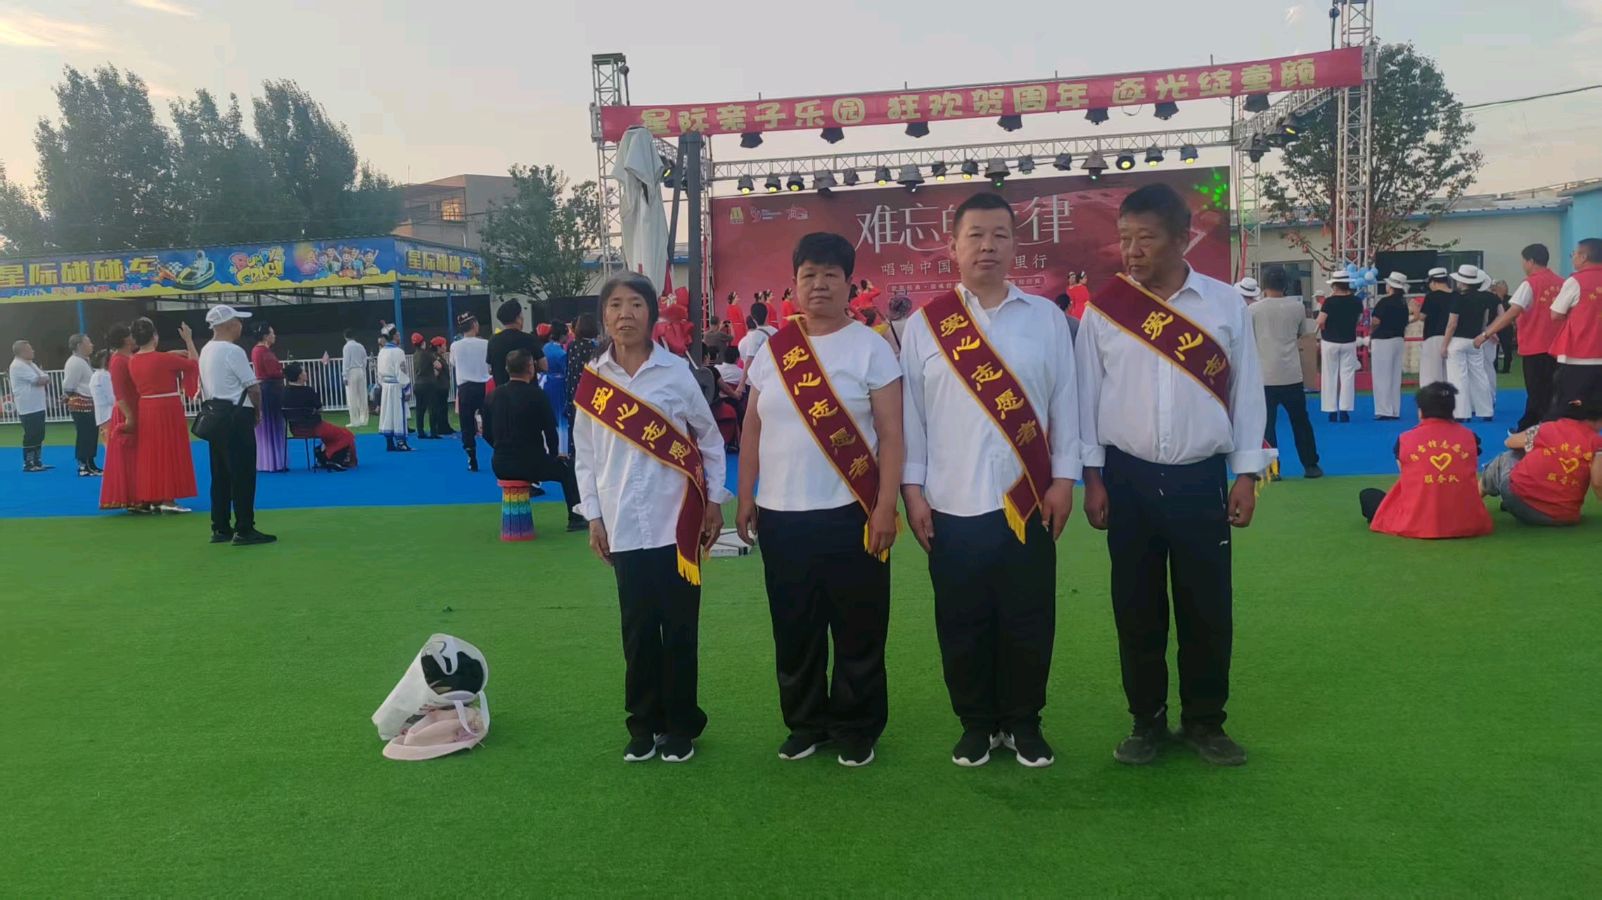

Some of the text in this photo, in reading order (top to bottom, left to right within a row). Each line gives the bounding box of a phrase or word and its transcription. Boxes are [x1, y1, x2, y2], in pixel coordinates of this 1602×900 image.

[640, 58, 1316, 134] 星际亲子乐园 狂欢贺周年 逐光绽童颜
